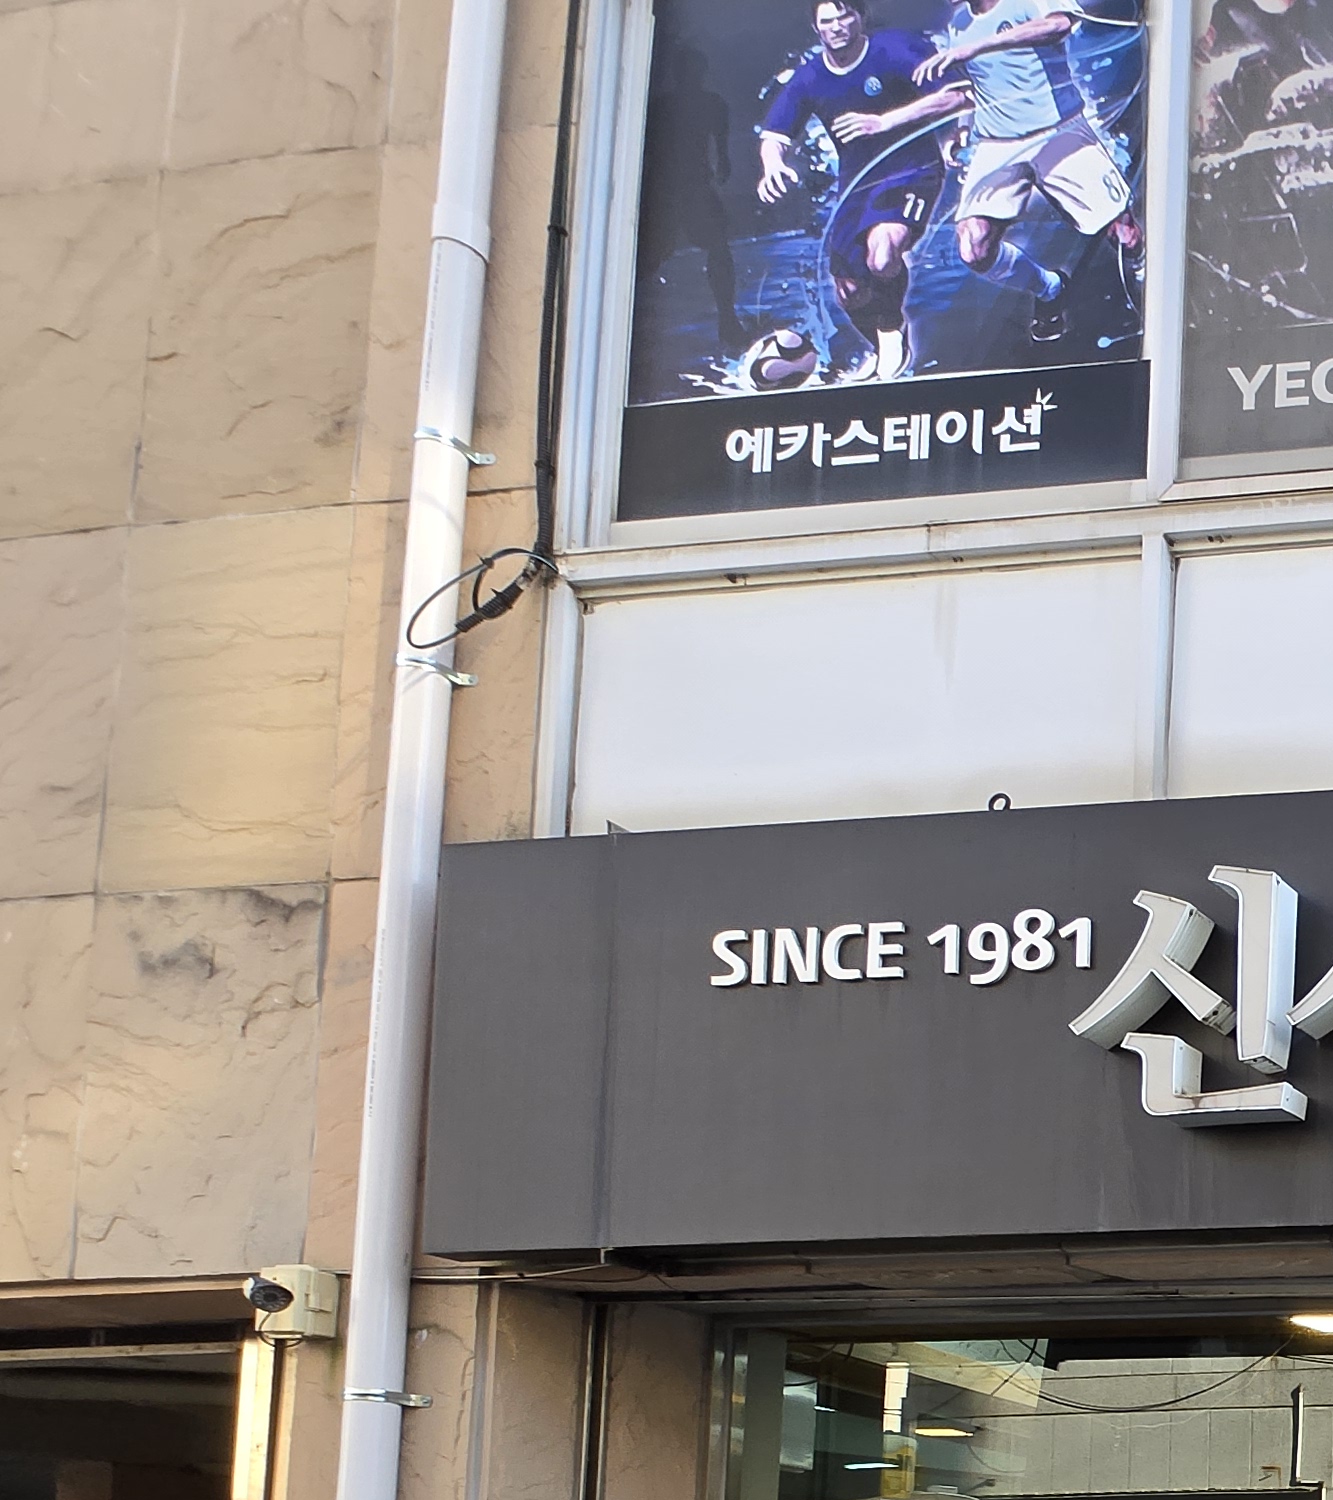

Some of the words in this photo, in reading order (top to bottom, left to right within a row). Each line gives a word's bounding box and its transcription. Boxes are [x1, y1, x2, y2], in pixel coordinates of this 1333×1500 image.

[725, 403, 1042, 474] 예카스테이션
[710, 921, 905, 987] SINCE
[927, 908, 1092, 986] 1981
